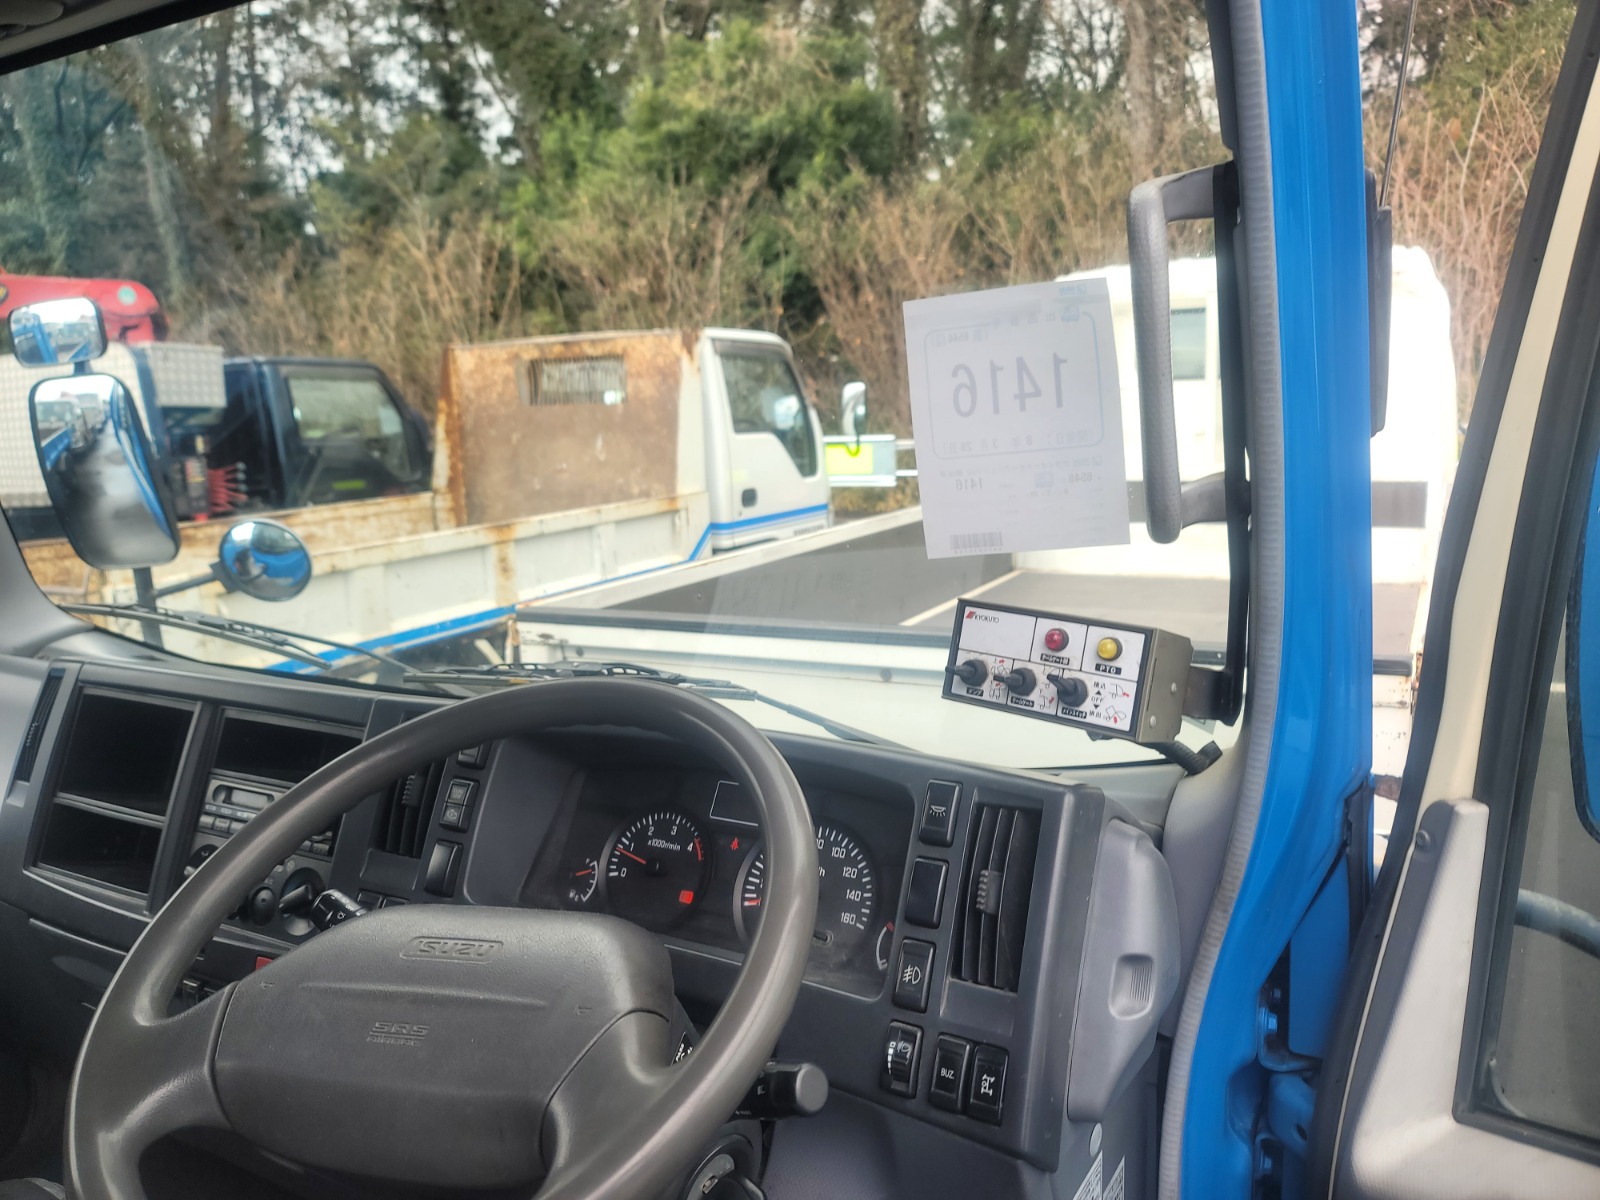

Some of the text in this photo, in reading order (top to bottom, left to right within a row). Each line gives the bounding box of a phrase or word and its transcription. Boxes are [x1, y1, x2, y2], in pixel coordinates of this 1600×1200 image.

[1100, 665, 1116, 674] PTO
[647, 826, 655, 836] 2
[670, 825, 678, 836] 3
[686, 843, 693, 852] 4
[831, 846, 846, 859] 100
[842, 866, 858, 879] 120
[845, 888, 862, 902] 140
[840, 911, 857, 925] 160
[417, 940, 495, 957] ISUZU
[372, 1021, 430, 1035] SRS
